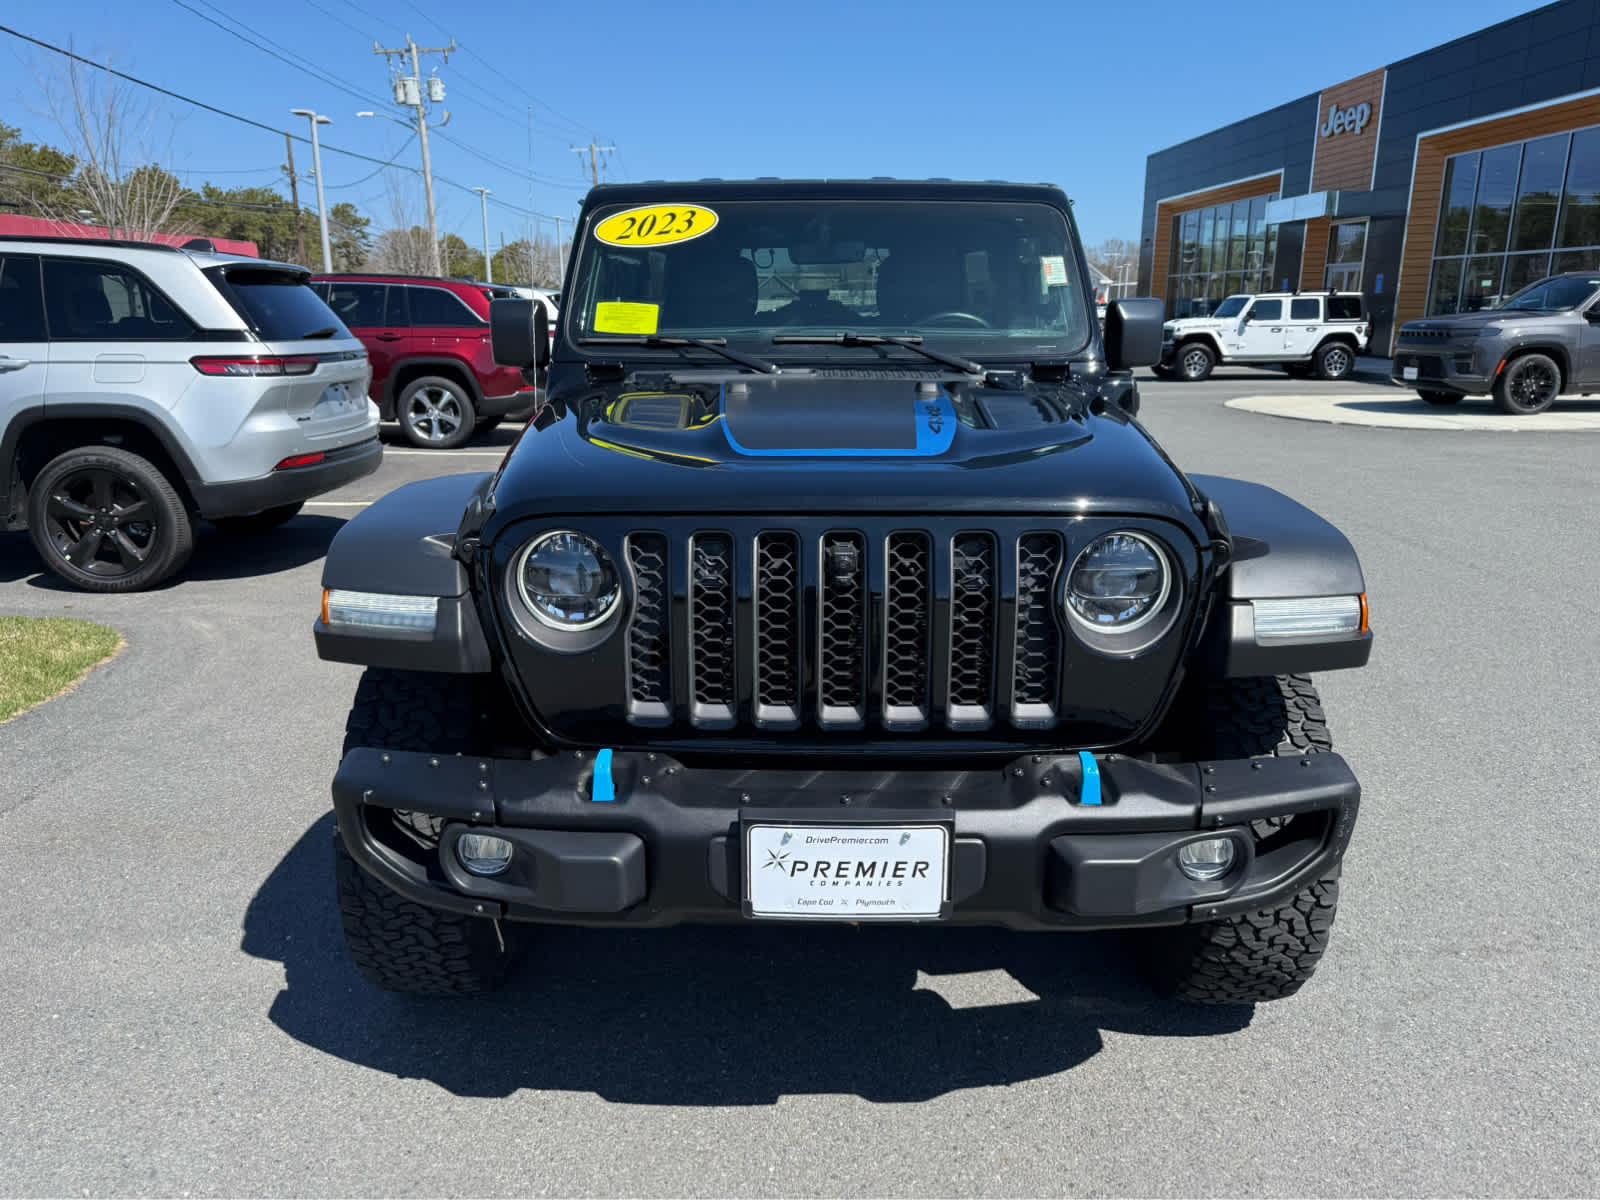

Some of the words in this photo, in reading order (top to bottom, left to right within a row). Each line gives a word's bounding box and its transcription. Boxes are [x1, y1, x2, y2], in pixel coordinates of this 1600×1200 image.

[1321, 103, 1372, 137] Jeep
[615, 209, 697, 241] 2023
[805, 835, 889, 845] DrivePremier.com
[790, 860, 930, 878] PREMIER
[856, 898, 896, 907] Plymouth
